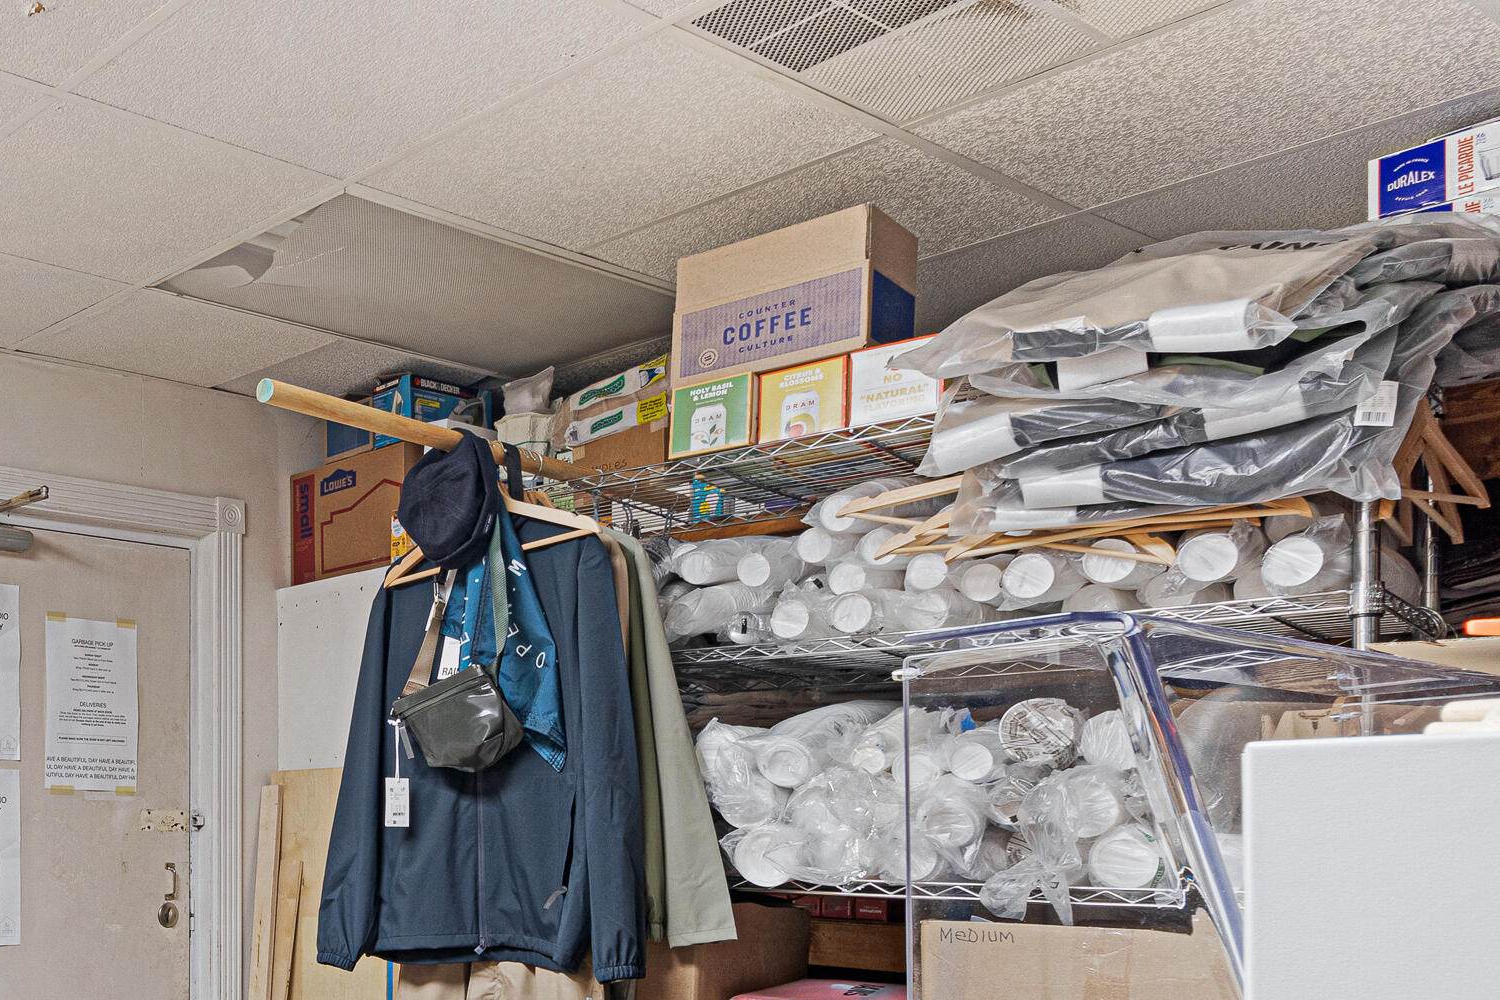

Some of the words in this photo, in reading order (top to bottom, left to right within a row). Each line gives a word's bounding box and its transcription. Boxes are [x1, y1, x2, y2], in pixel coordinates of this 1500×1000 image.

[1458, 135, 1474, 182] PICARDIE
[1458, 182, 1474, 196] LE
[738, 299, 797, 320] COUNTER
[722, 306, 813, 346] COFFEE
[738, 334, 794, 354] CULTURE
[779, 372, 824, 388] BLOSSOMS
[784, 370, 812, 382] CITRUS
[883, 373, 903, 384] NO
[690, 385, 710, 397] HOLY
[711, 381, 734, 392] BASIL
[700, 389, 728, 401] LEMON
[786, 399, 815, 411] DRAM
[695, 413, 722, 424] DRAM
[323, 475, 353, 493] LOWE'S
[299, 483, 313, 540] small
[71, 638, 94, 646] GARBAGE
[79, 701, 107, 709] DELIVERIES
